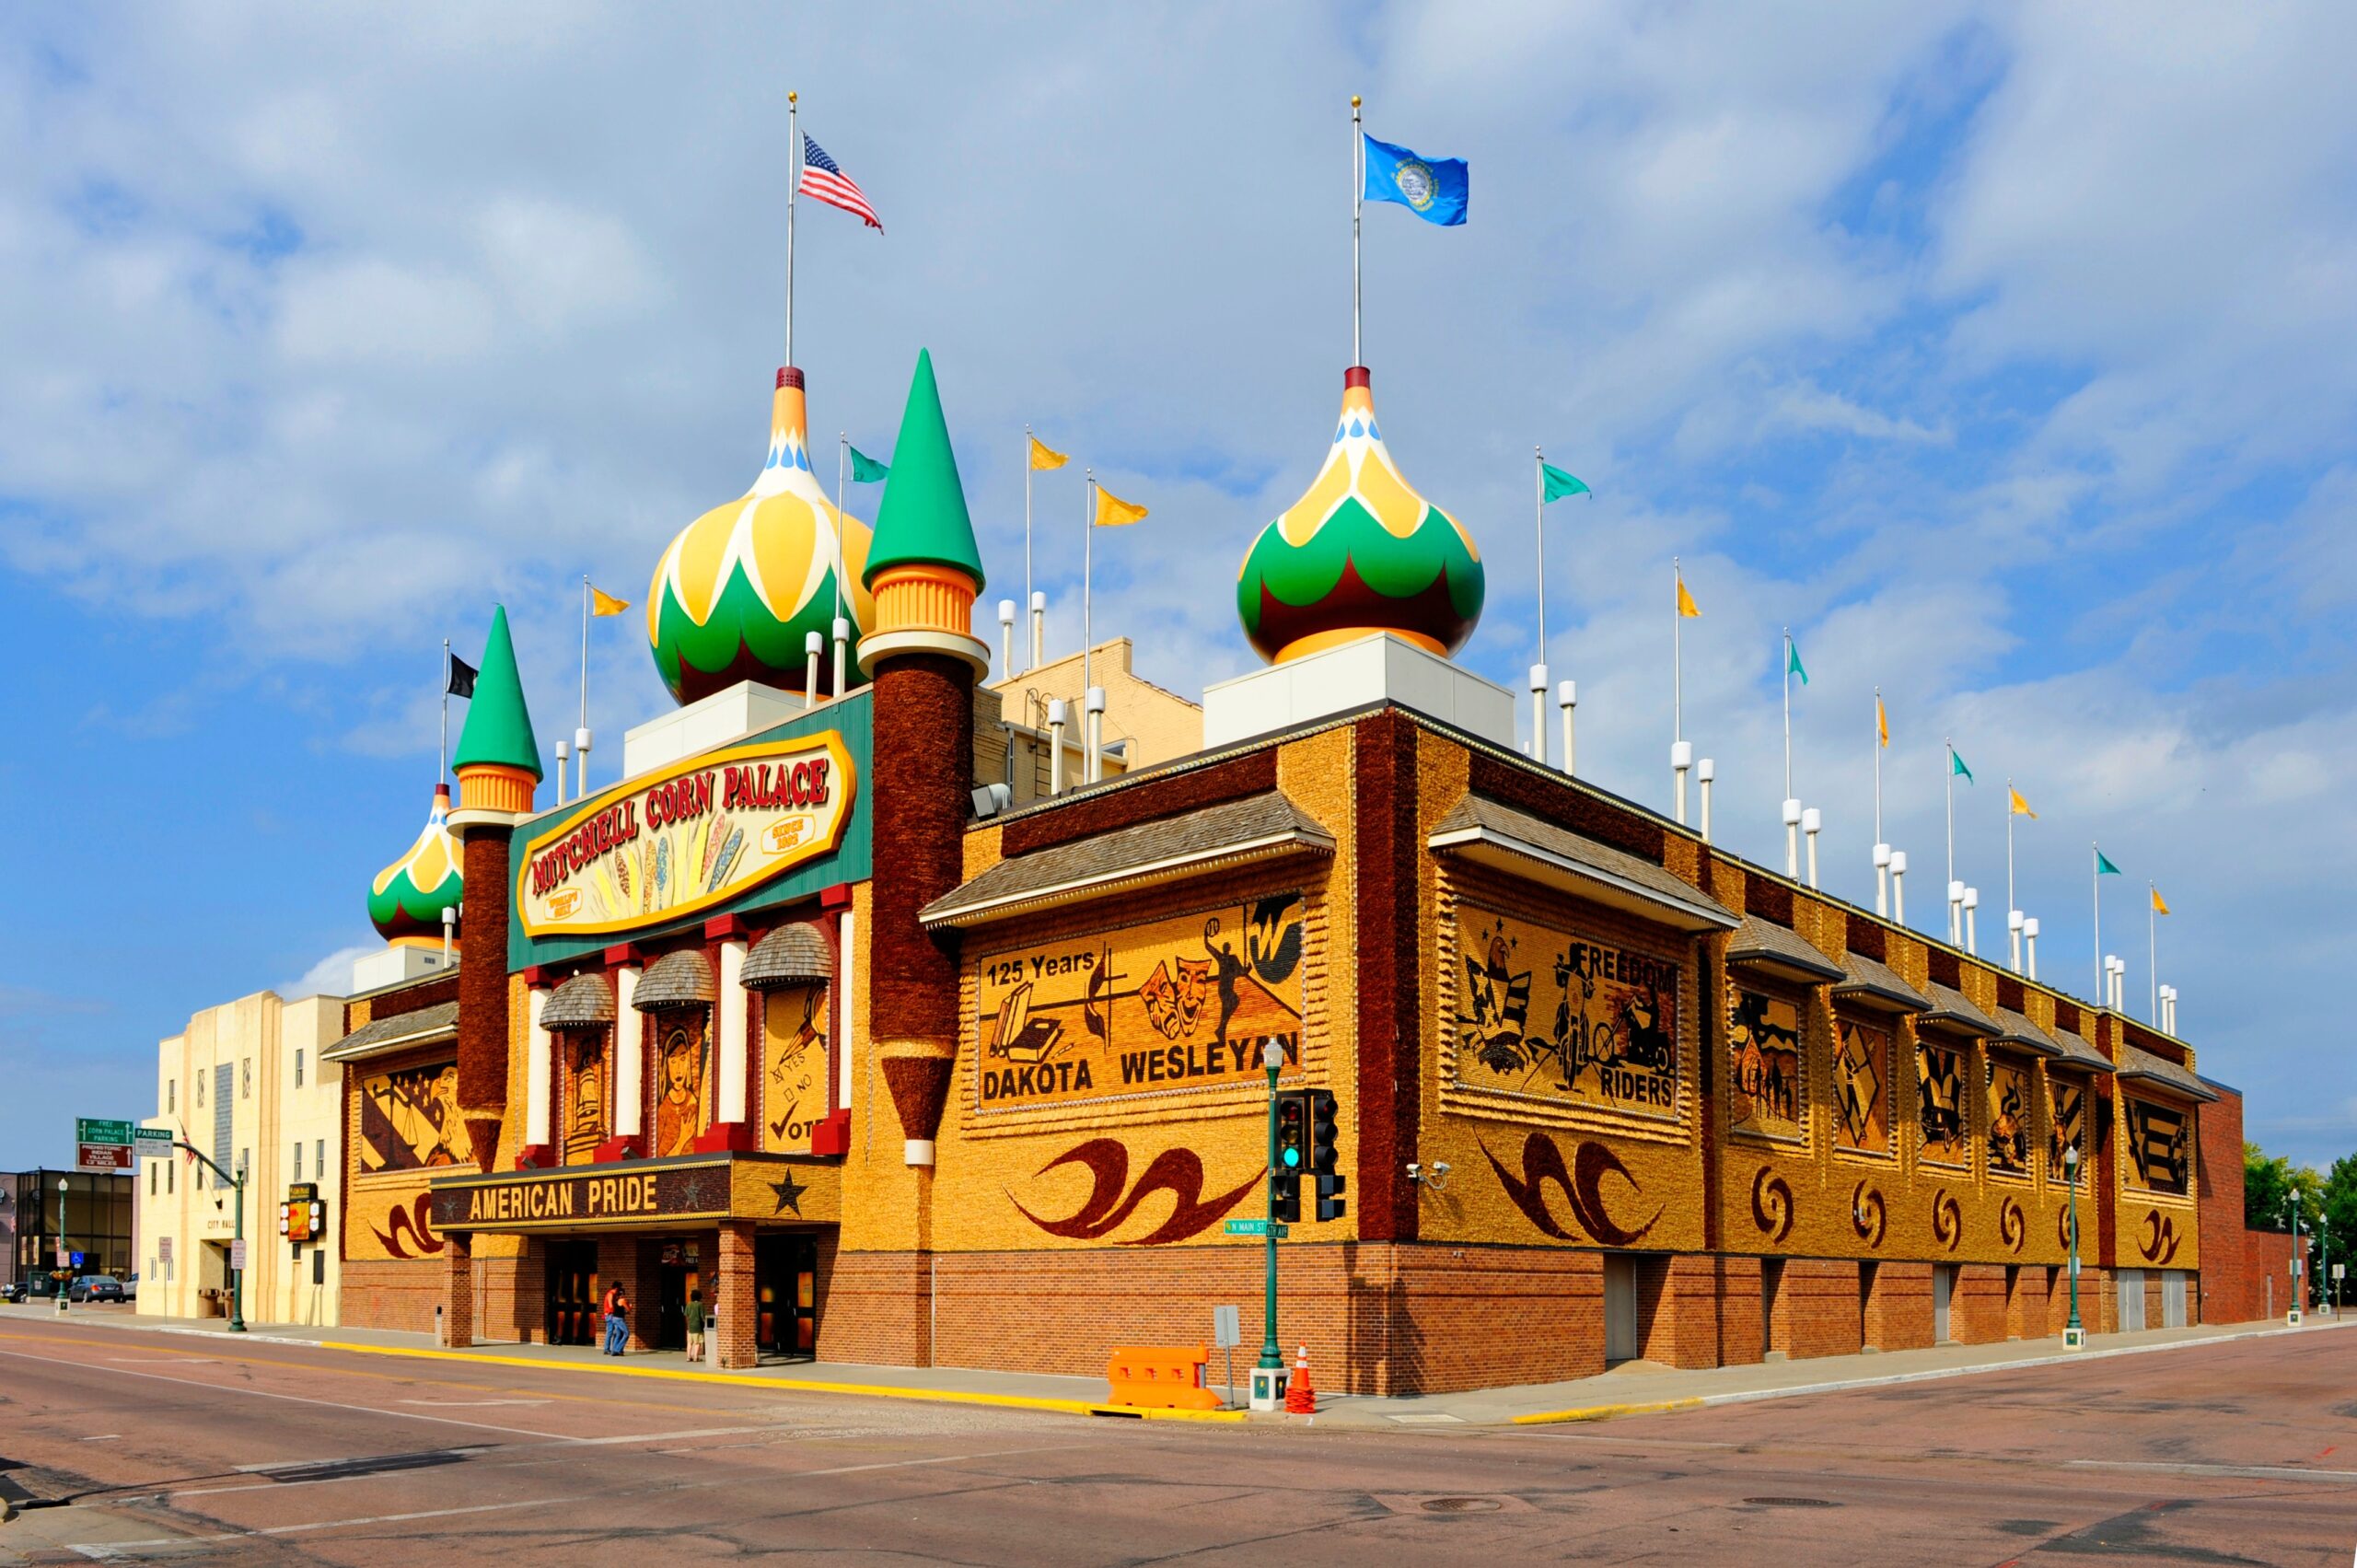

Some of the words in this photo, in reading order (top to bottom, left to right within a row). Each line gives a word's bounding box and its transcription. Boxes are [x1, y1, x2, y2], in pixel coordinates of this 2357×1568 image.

[532, 799, 638, 897] MITCHELL
[645, 771, 714, 830] CORN
[722, 758, 828, 810] PALACE
[772, 819, 804, 839] SINCE
[987, 958, 1024, 987] 125
[1030, 951, 1095, 979] Years
[1570, 942, 1678, 994] FREEDOM
[784, 1052, 806, 1073] YES
[796, 1074, 812, 1094] NO
[983, 1058, 1093, 1100] DAKOTA
[1600, 1067, 1672, 1108] RIDERS
[770, 1100, 824, 1141] VOT
[104, 1128, 124, 1136] PALACE
[137, 1130, 170, 1139] PARKING
[470, 1181, 573, 1220] AMERICAN
[588, 1175, 657, 1214] PRIDE
[207, 1220, 220, 1230] CITY
[222, 1219, 236, 1229] HALL
[1231, 1222, 1237, 1231] N
[1239, 1222, 1255, 1232] MAIN
[1257, 1222, 1265, 1232] ST
[1267, 1225, 1276, 1237] 6TH
[1278, 1225, 1288, 1237] AVE
